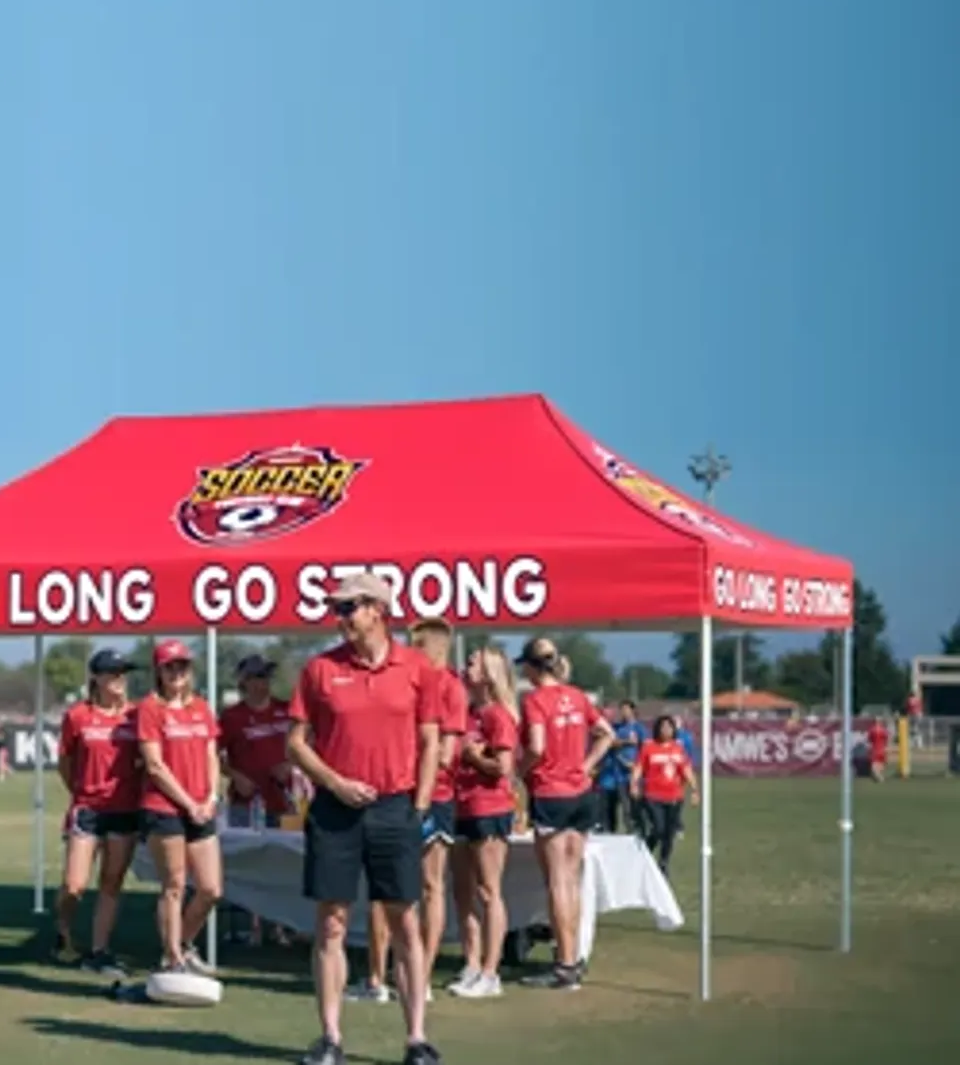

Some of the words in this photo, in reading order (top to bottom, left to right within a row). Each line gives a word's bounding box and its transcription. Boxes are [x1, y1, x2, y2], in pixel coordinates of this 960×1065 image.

[191, 462, 355, 503] SOCCER
[9, 568, 155, 624] LONG
[193, 564, 277, 622] GO
